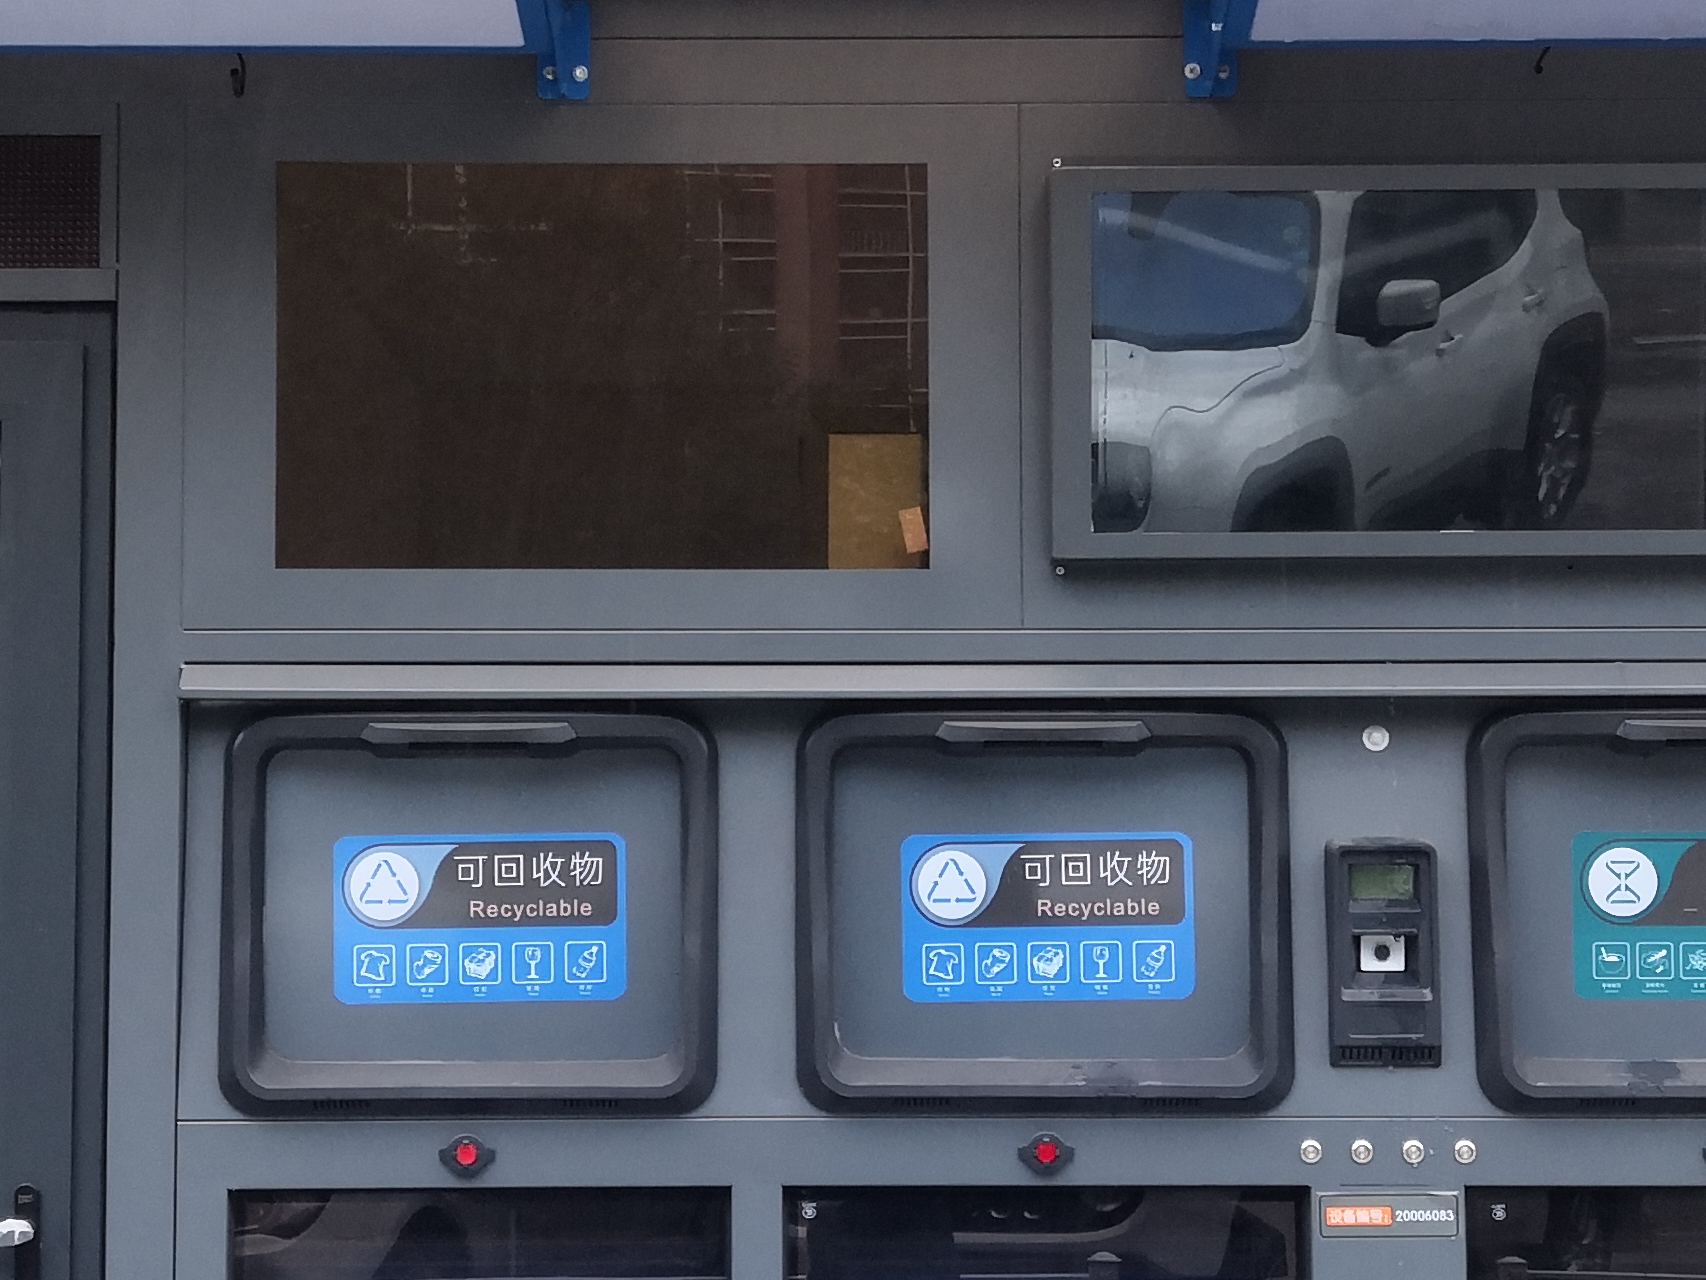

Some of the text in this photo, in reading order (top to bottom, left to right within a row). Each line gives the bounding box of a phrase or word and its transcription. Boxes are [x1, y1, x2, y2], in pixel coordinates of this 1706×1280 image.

[453, 851, 603, 888] 可回收物
[1020, 850, 1170, 887] 可回收物
[469, 899, 592, 922] Recyclable
[1037, 898, 1160, 920] Recyclable
[1395, 1209, 1455, 1222] 20006083
